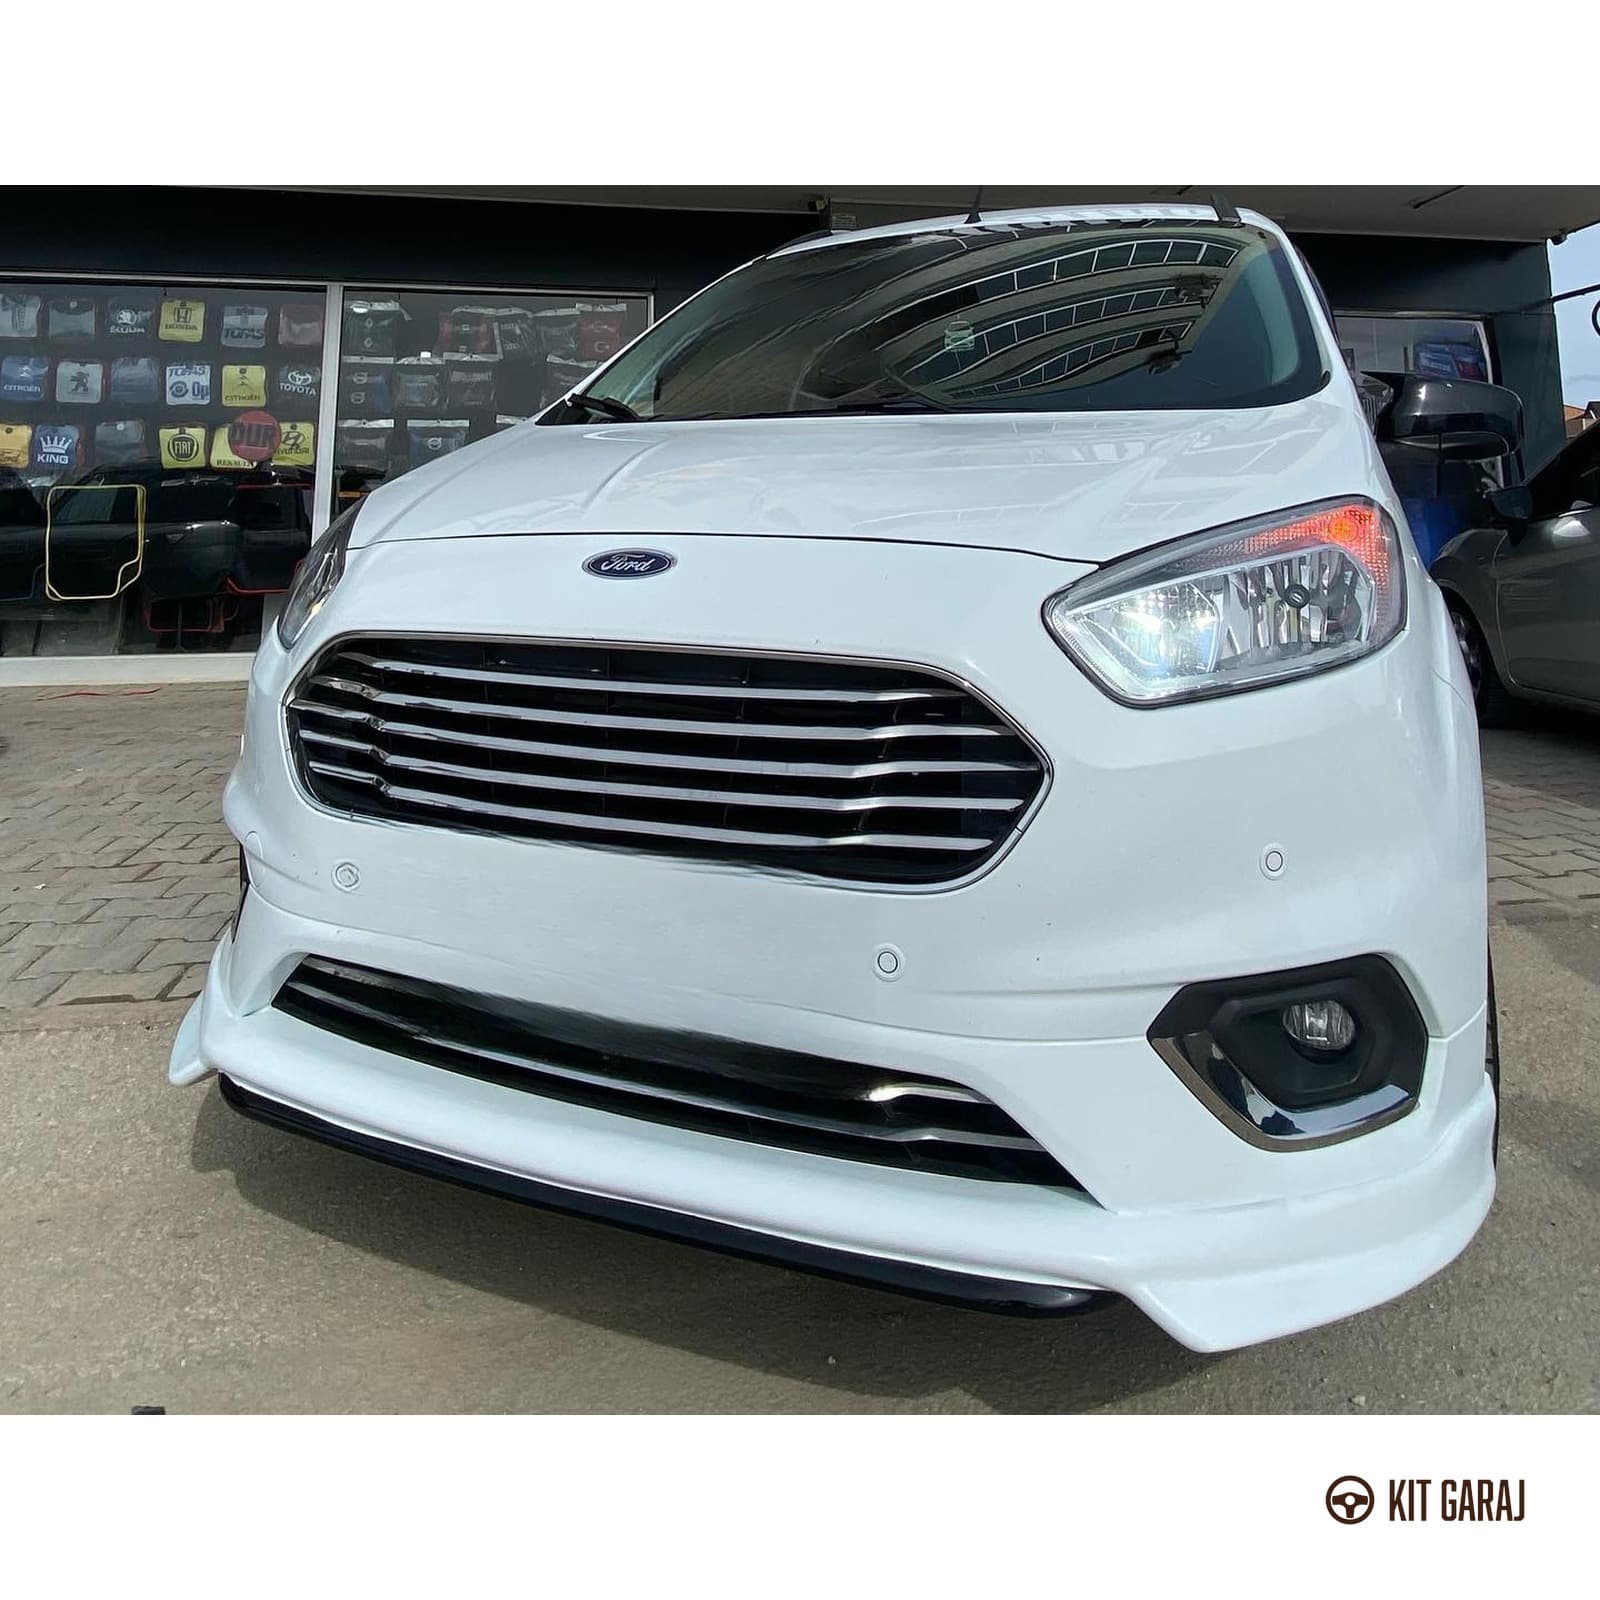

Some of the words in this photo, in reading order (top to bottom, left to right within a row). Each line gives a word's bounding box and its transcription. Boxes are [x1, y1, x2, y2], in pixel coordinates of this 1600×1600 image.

[279, 382, 317, 396] TOYOTA
[174, 440, 192, 454] FIAT
[37, 454, 69, 465] KING
[601, 553, 656, 572] Ford
